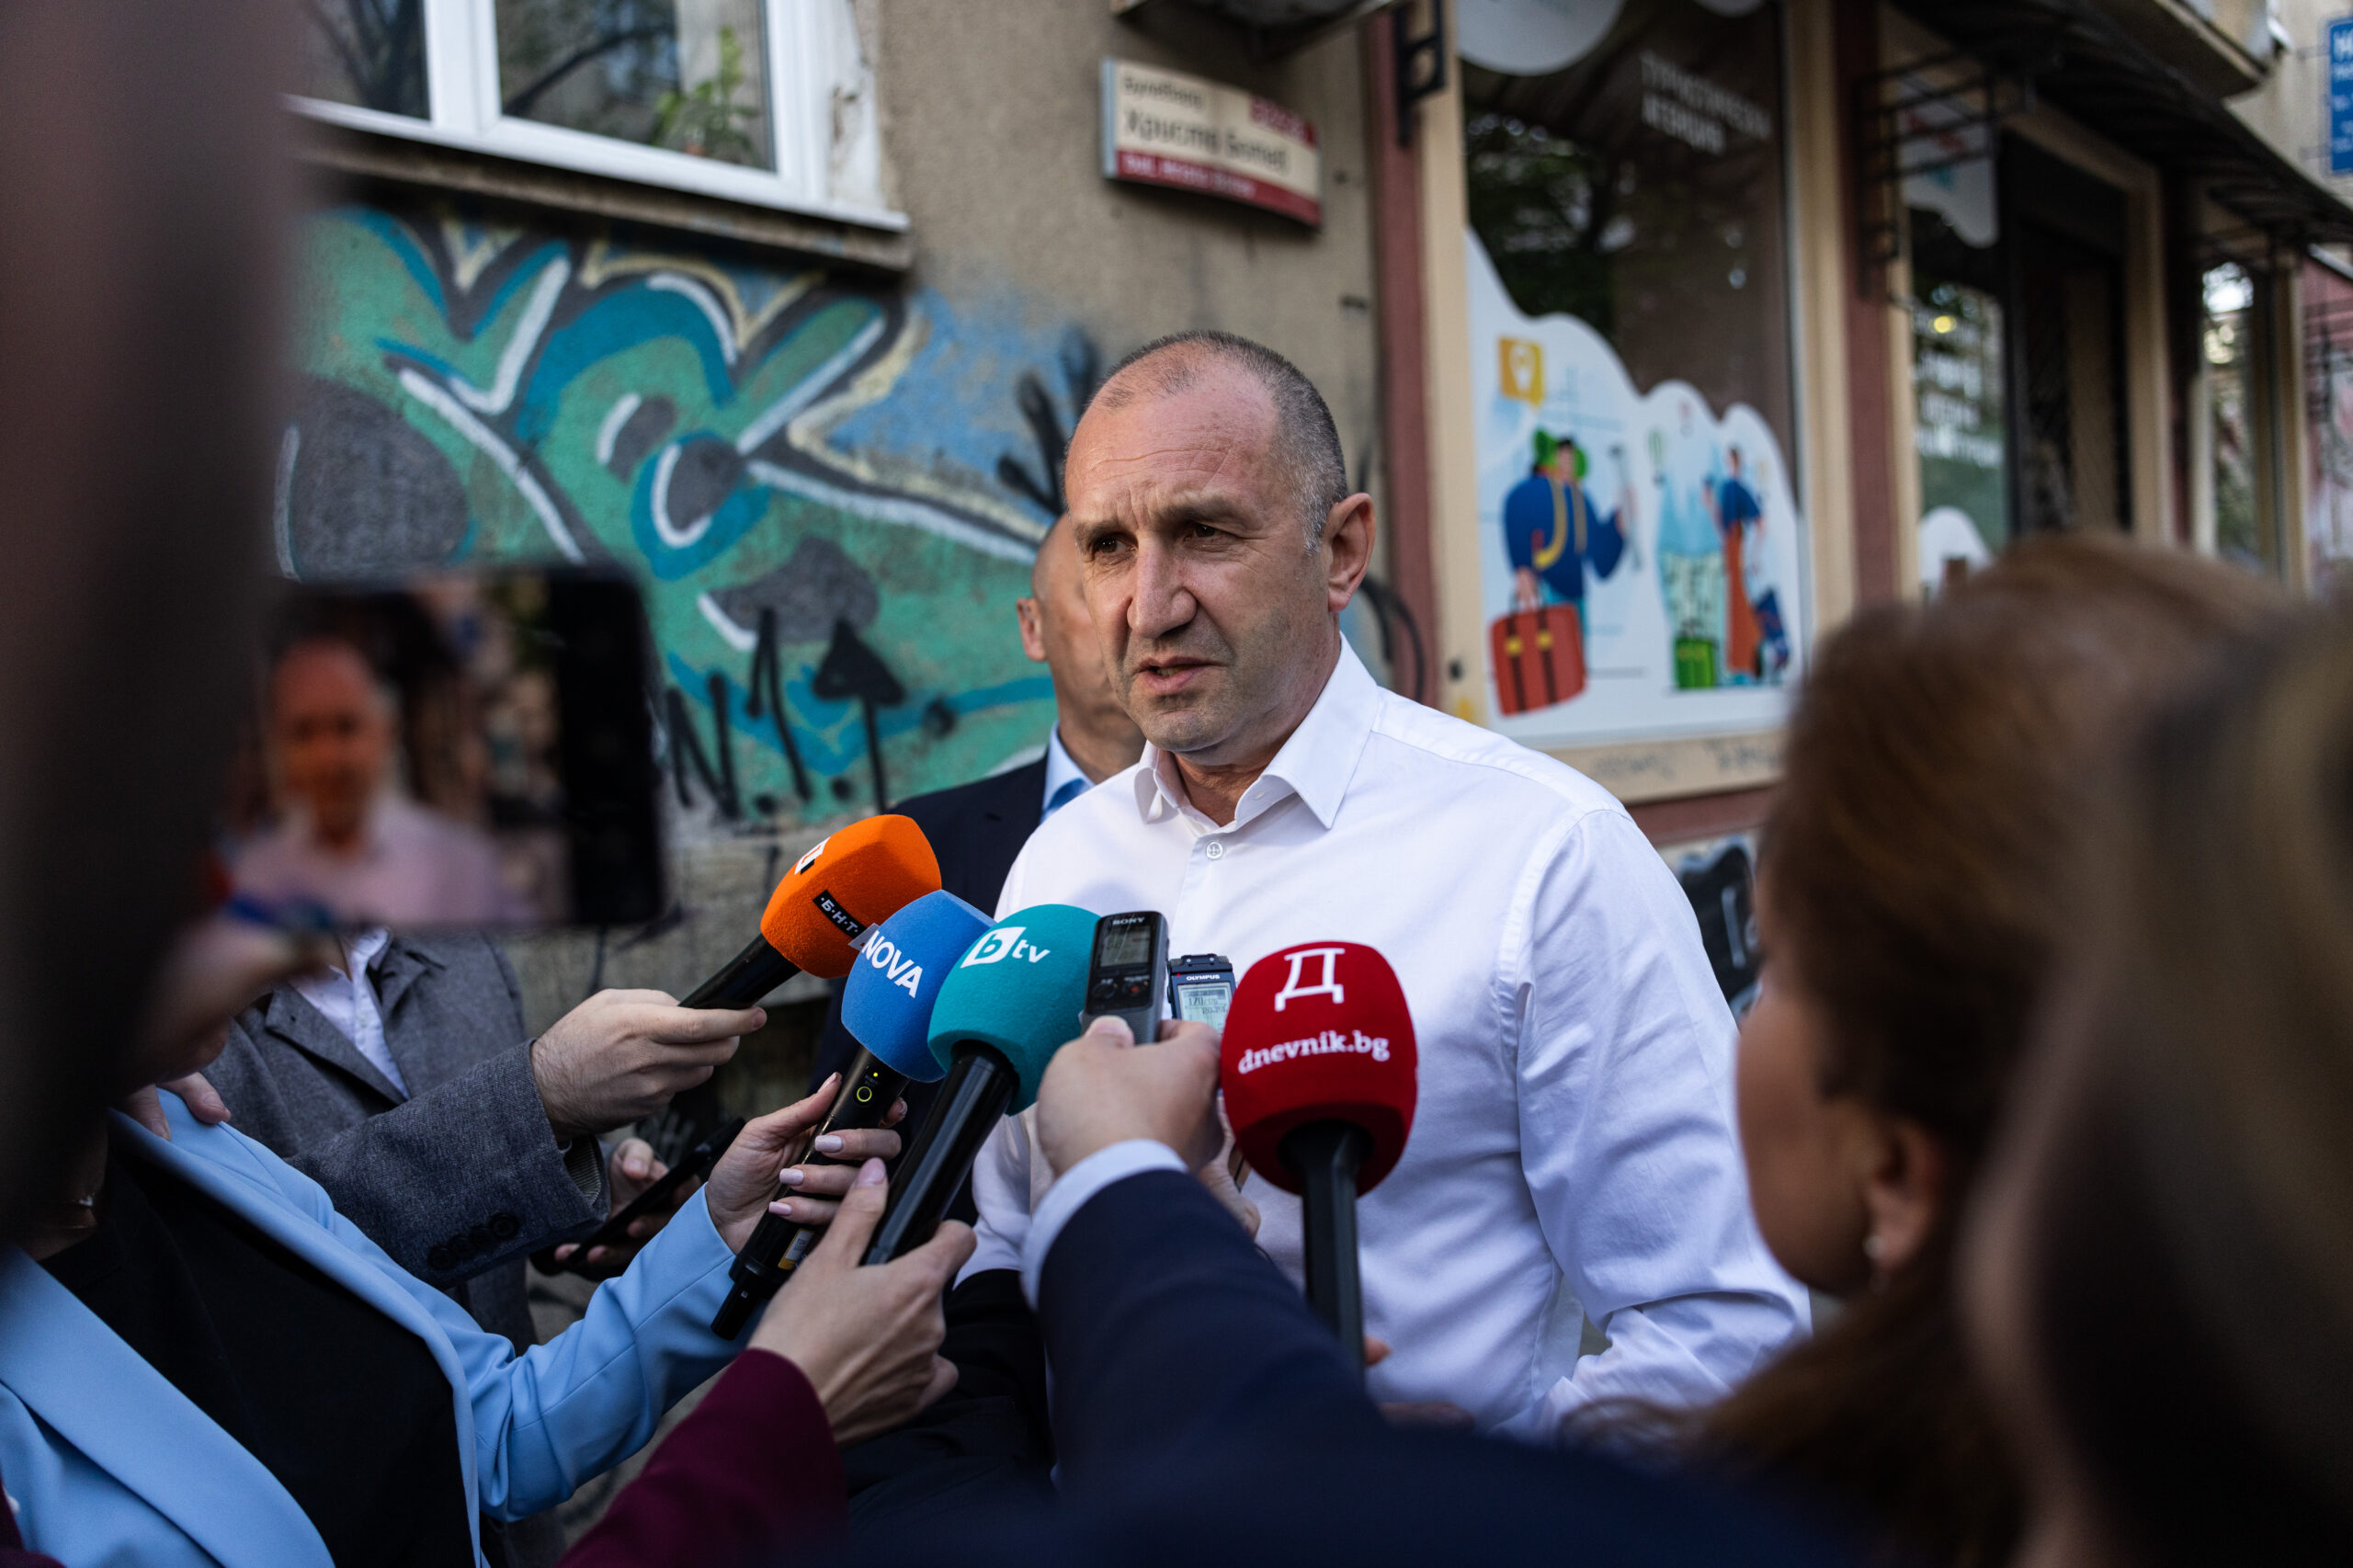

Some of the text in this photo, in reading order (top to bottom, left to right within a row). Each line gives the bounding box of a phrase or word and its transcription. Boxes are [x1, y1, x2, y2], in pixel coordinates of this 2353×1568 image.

[1112, 916, 1145, 926] SONY
[861, 929, 924, 999] NOVA
[1186, 973, 1221, 982] OLYMPUS
[1274, 948, 1346, 1012] Д
[1238, 1029, 1390, 1074] dnevnik.bg
